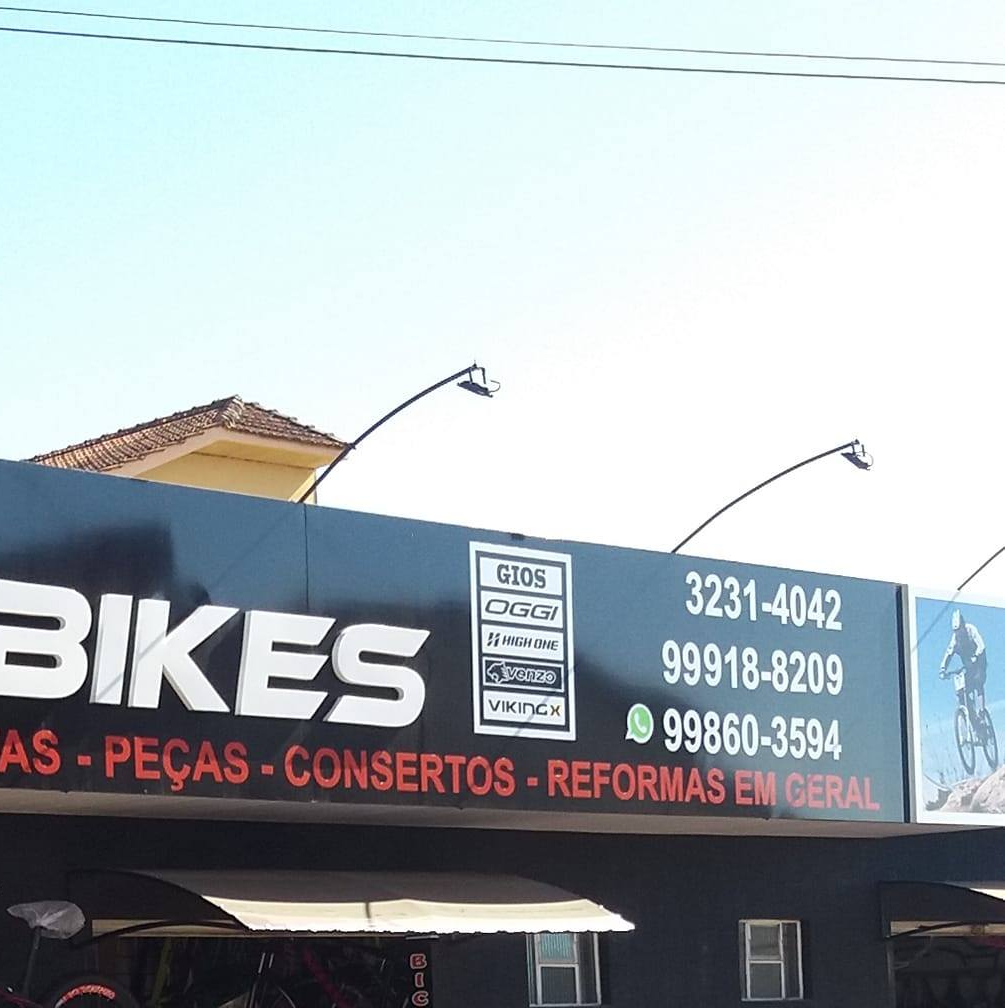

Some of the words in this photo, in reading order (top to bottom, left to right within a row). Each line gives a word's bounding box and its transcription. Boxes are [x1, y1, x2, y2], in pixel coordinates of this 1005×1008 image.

[496, 563, 546, 589] GIOS
[685, 570, 843, 631] 3231-4042
[484, 599, 559, 621] OGGI
[502, 635, 533, 649] HIGH
[534, 638, 559, 651] ONE
[661, 639, 844, 696] 99918-8209
[662, 708, 843, 761] 99860-3594
[104, 735, 250, 792] PEÇAS
[284, 745, 516, 797] CONSERTOS
[547, 759, 726, 805] REFORMAS
[734, 770, 776, 806] EM
[784, 772, 880, 811] GERAL
